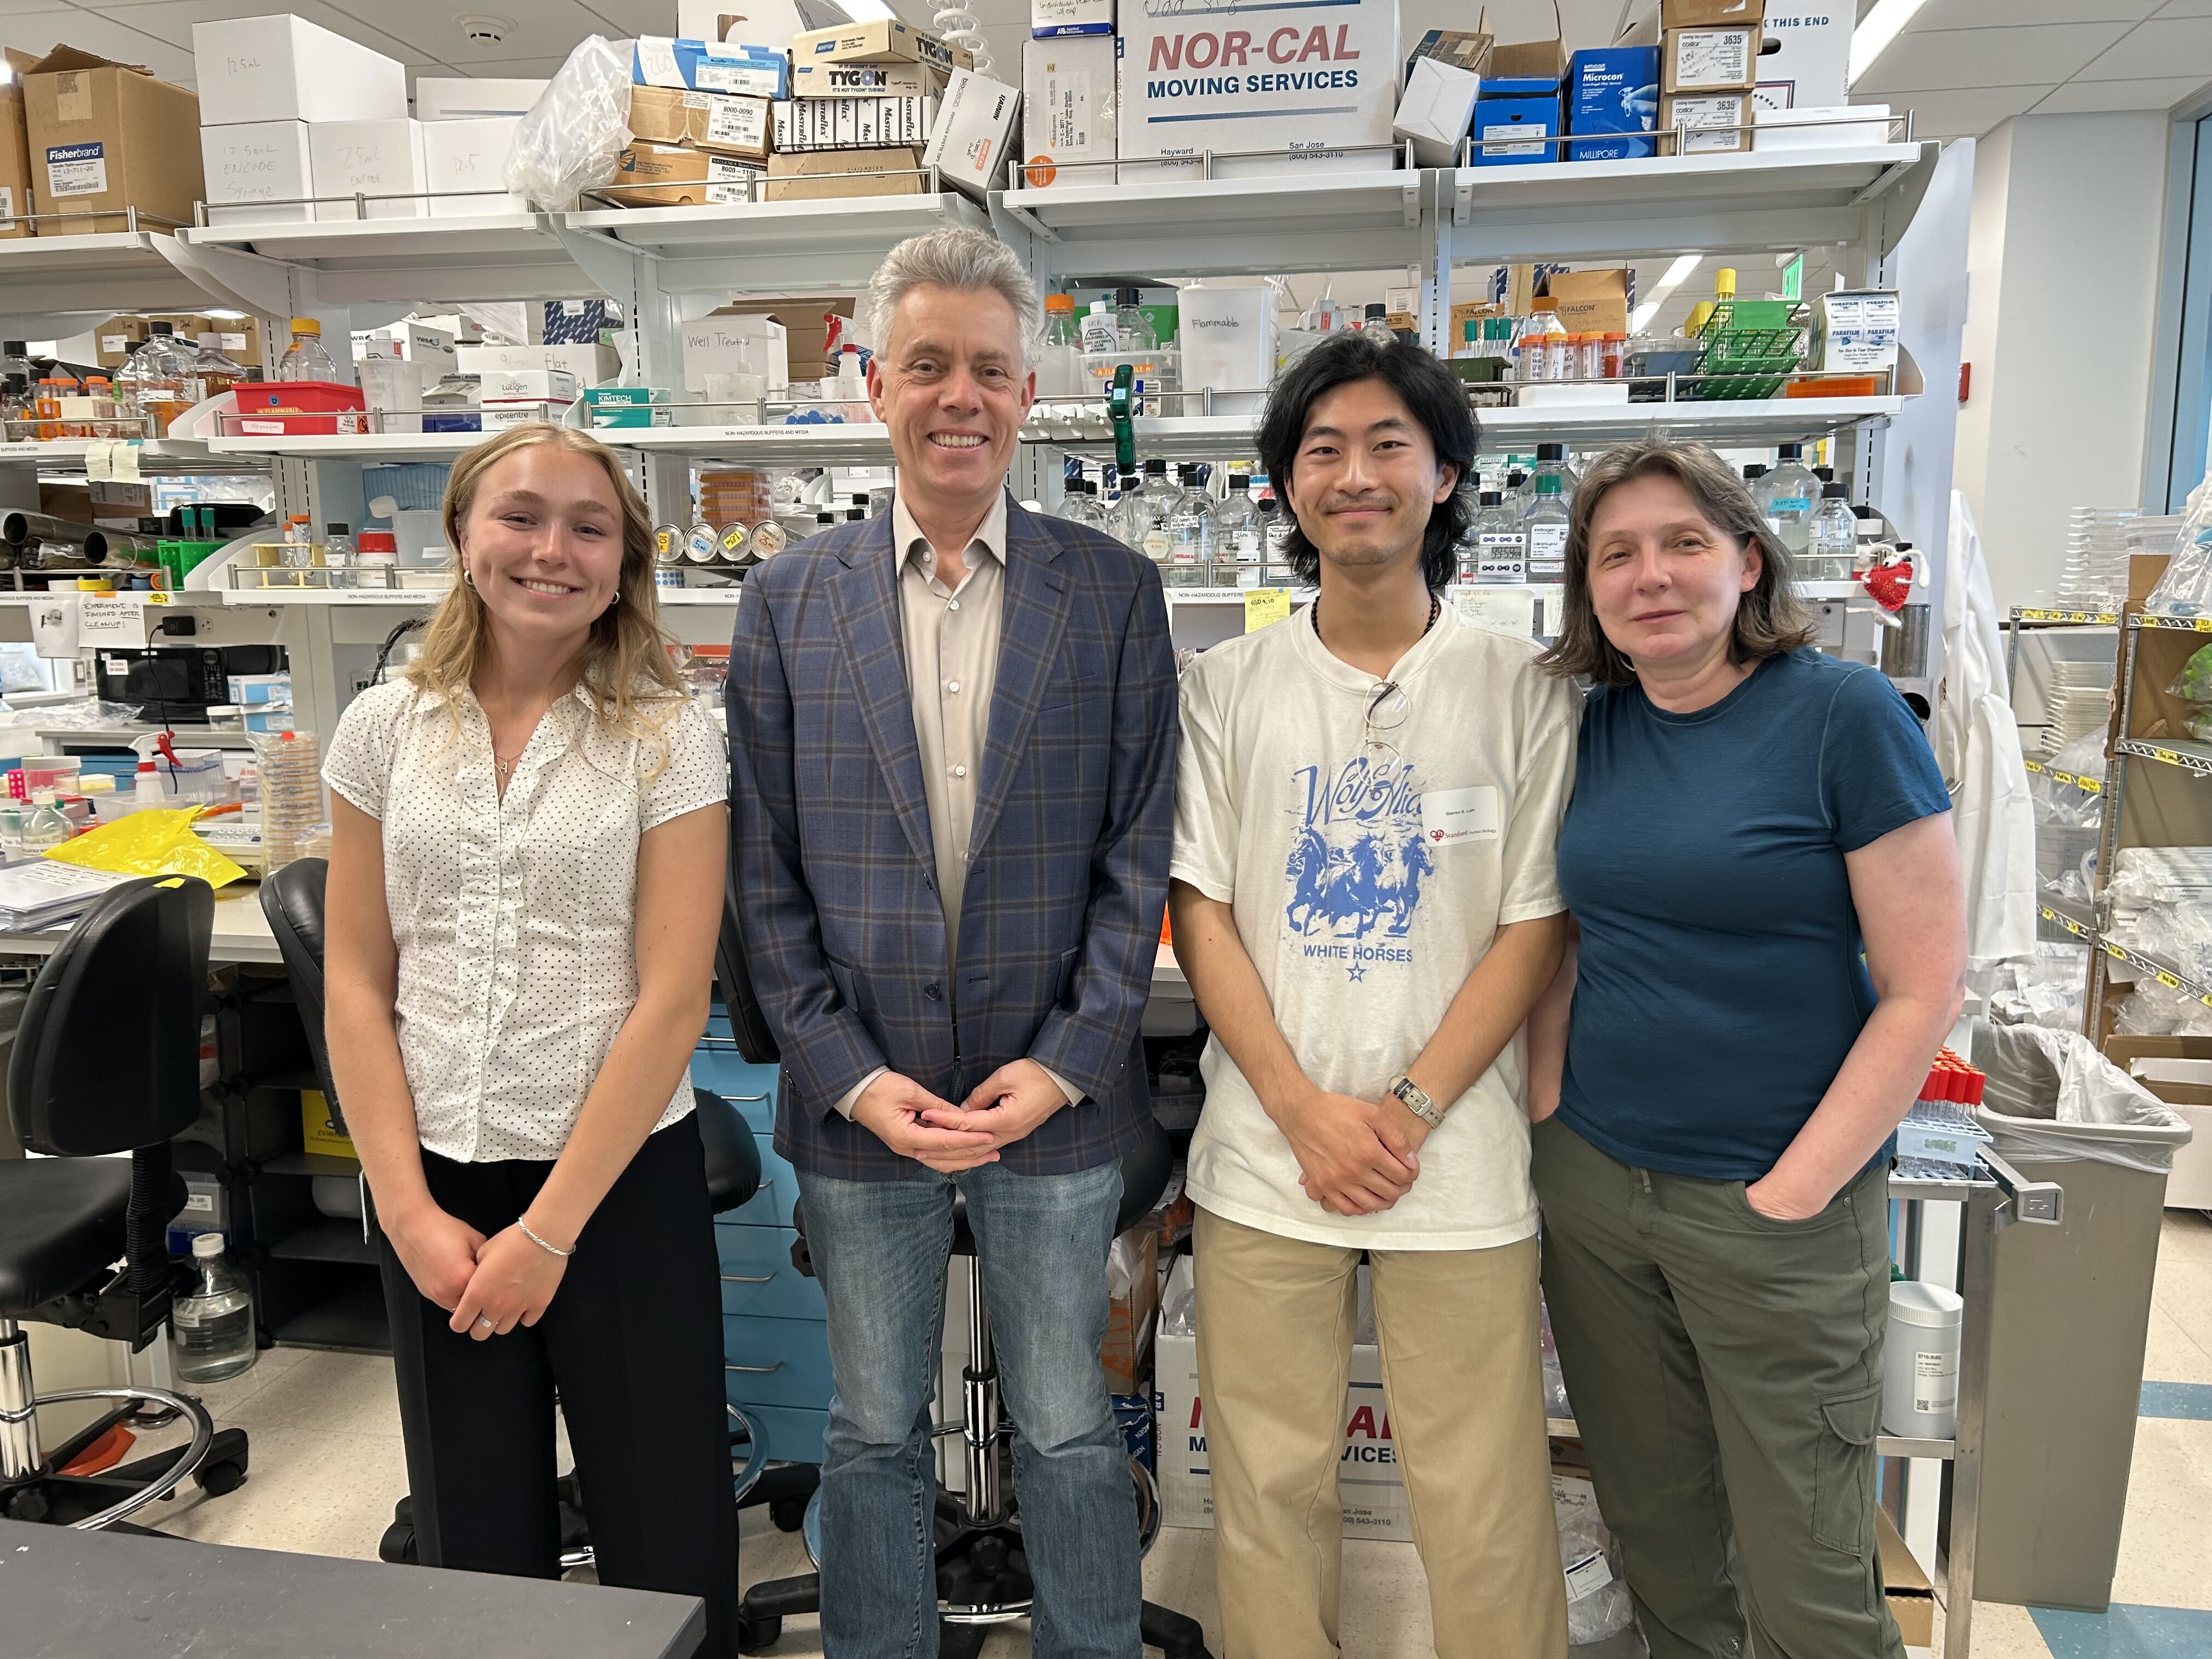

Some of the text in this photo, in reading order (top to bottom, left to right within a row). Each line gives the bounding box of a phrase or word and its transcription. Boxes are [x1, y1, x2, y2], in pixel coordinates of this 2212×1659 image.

[1773, 18, 1800, 27] THIS
[1804, 16, 1829, 26] END
[1723, 35, 1742, 45] 3635
[916, 36, 953, 65] TYGON
[1148, 24, 1361, 72] NOR-CAL
[829, 70, 888, 87] TYGON
[1583, 74, 1624, 82] Microcon
[1147, 69, 1359, 99] MOVING SERVICES
[723, 106, 753, 115] 8000-0090
[1717, 100, 1735, 111] 3635
[49, 146, 100, 160] Fisherbrand
[1161, 148, 1193, 157] Hayward
[1579, 149, 1619, 159] MILLIPORE
[223, 161, 277, 175] ENCODE
[350, 173, 382, 186] ENCODE
[1192, 317, 1240, 328] Flammable
[687, 334, 709, 348] Well
[502, 381, 528, 391] Lucigen
[495, 411, 529, 421] epicentre
[693, 529, 714, 545] SHERLOCK
[758, 535, 768, 545] 25
[694, 539, 700, 548] 5
[1294, 757, 1368, 827] Wolf
[1445, 830, 1468, 838] Stanford
[1304, 945, 1412, 962] WHITE HORSES
[1355, 1517, 1391, 1527] 543-3110
